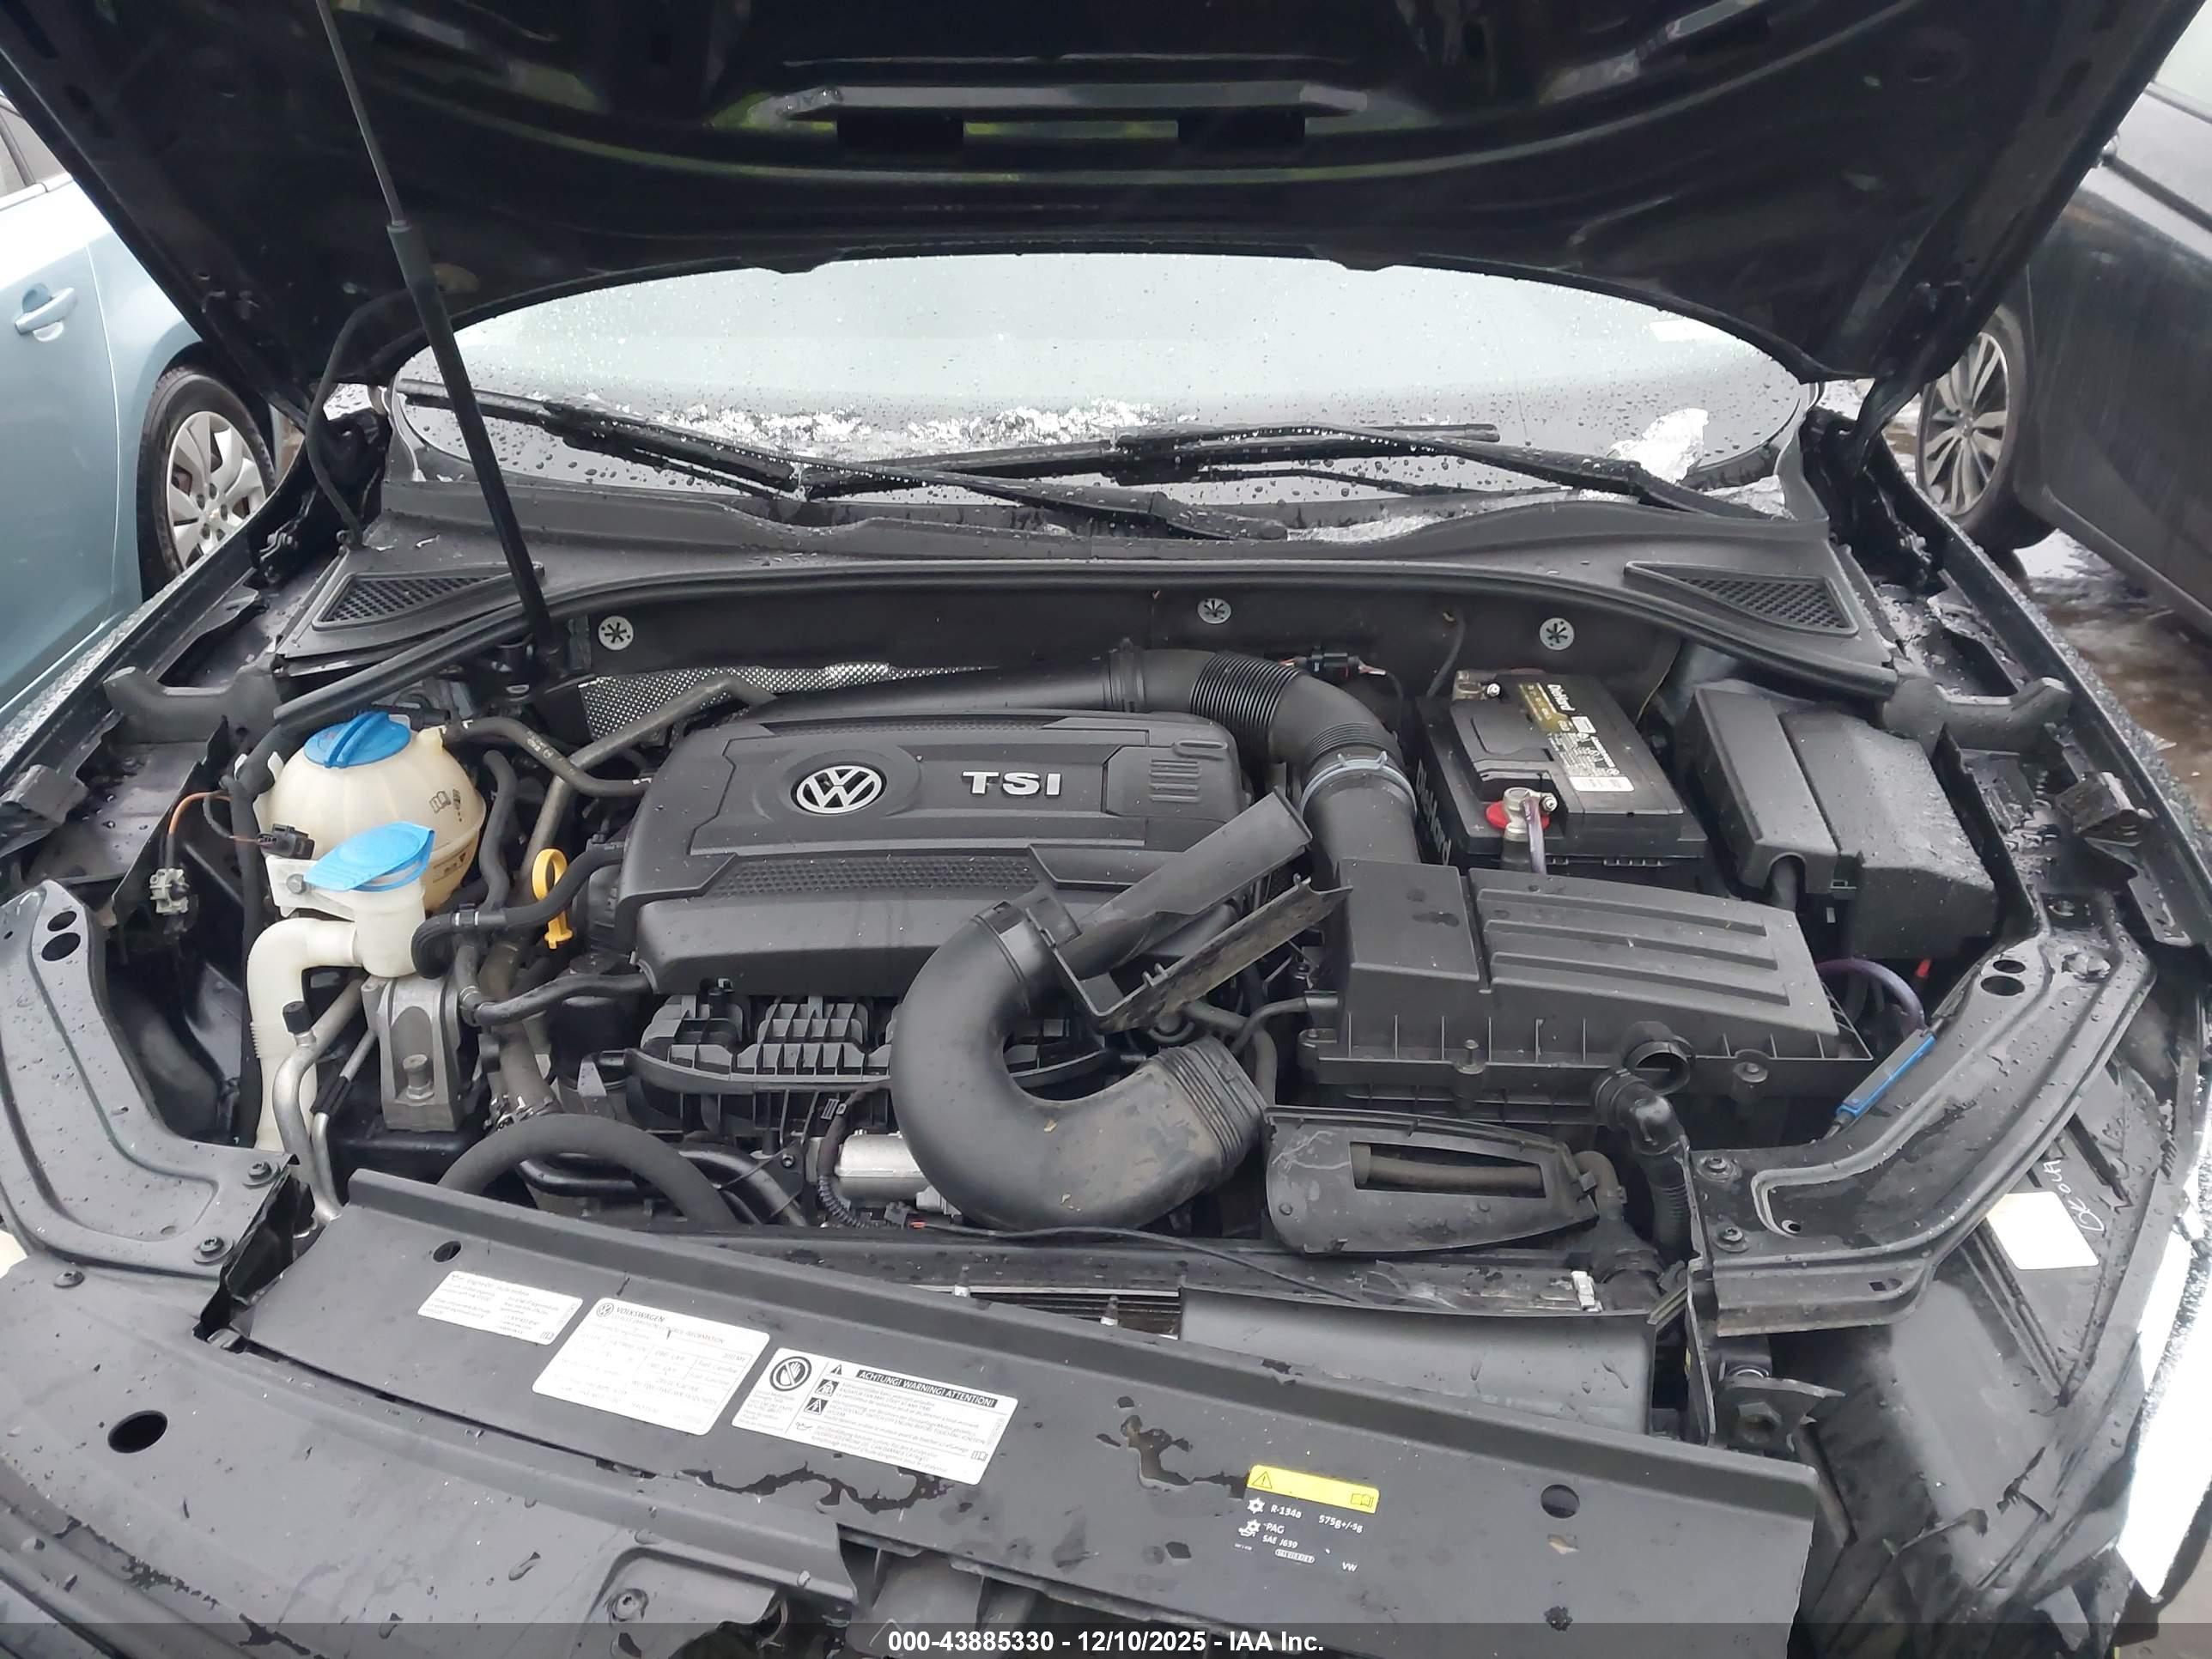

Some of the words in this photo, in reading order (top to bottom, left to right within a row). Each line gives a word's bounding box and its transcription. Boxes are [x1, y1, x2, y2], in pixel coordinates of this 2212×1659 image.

[961, 771, 1063, 797] TSI
[615, 1305, 665, 1323] VOLKSWAGEN
[860, 1370, 902, 1387] ACHTUNG!
[902, 1380, 945, 1395] WARNING!
[944, 1389, 995, 1407] ATTENTION!
[1270, 1504, 1302, 1519] R-134a
[1262, 1534, 1277, 1545] SAE
[1279, 1538, 1298, 1549] J639
[1342, 1561, 1358, 1572] VW
